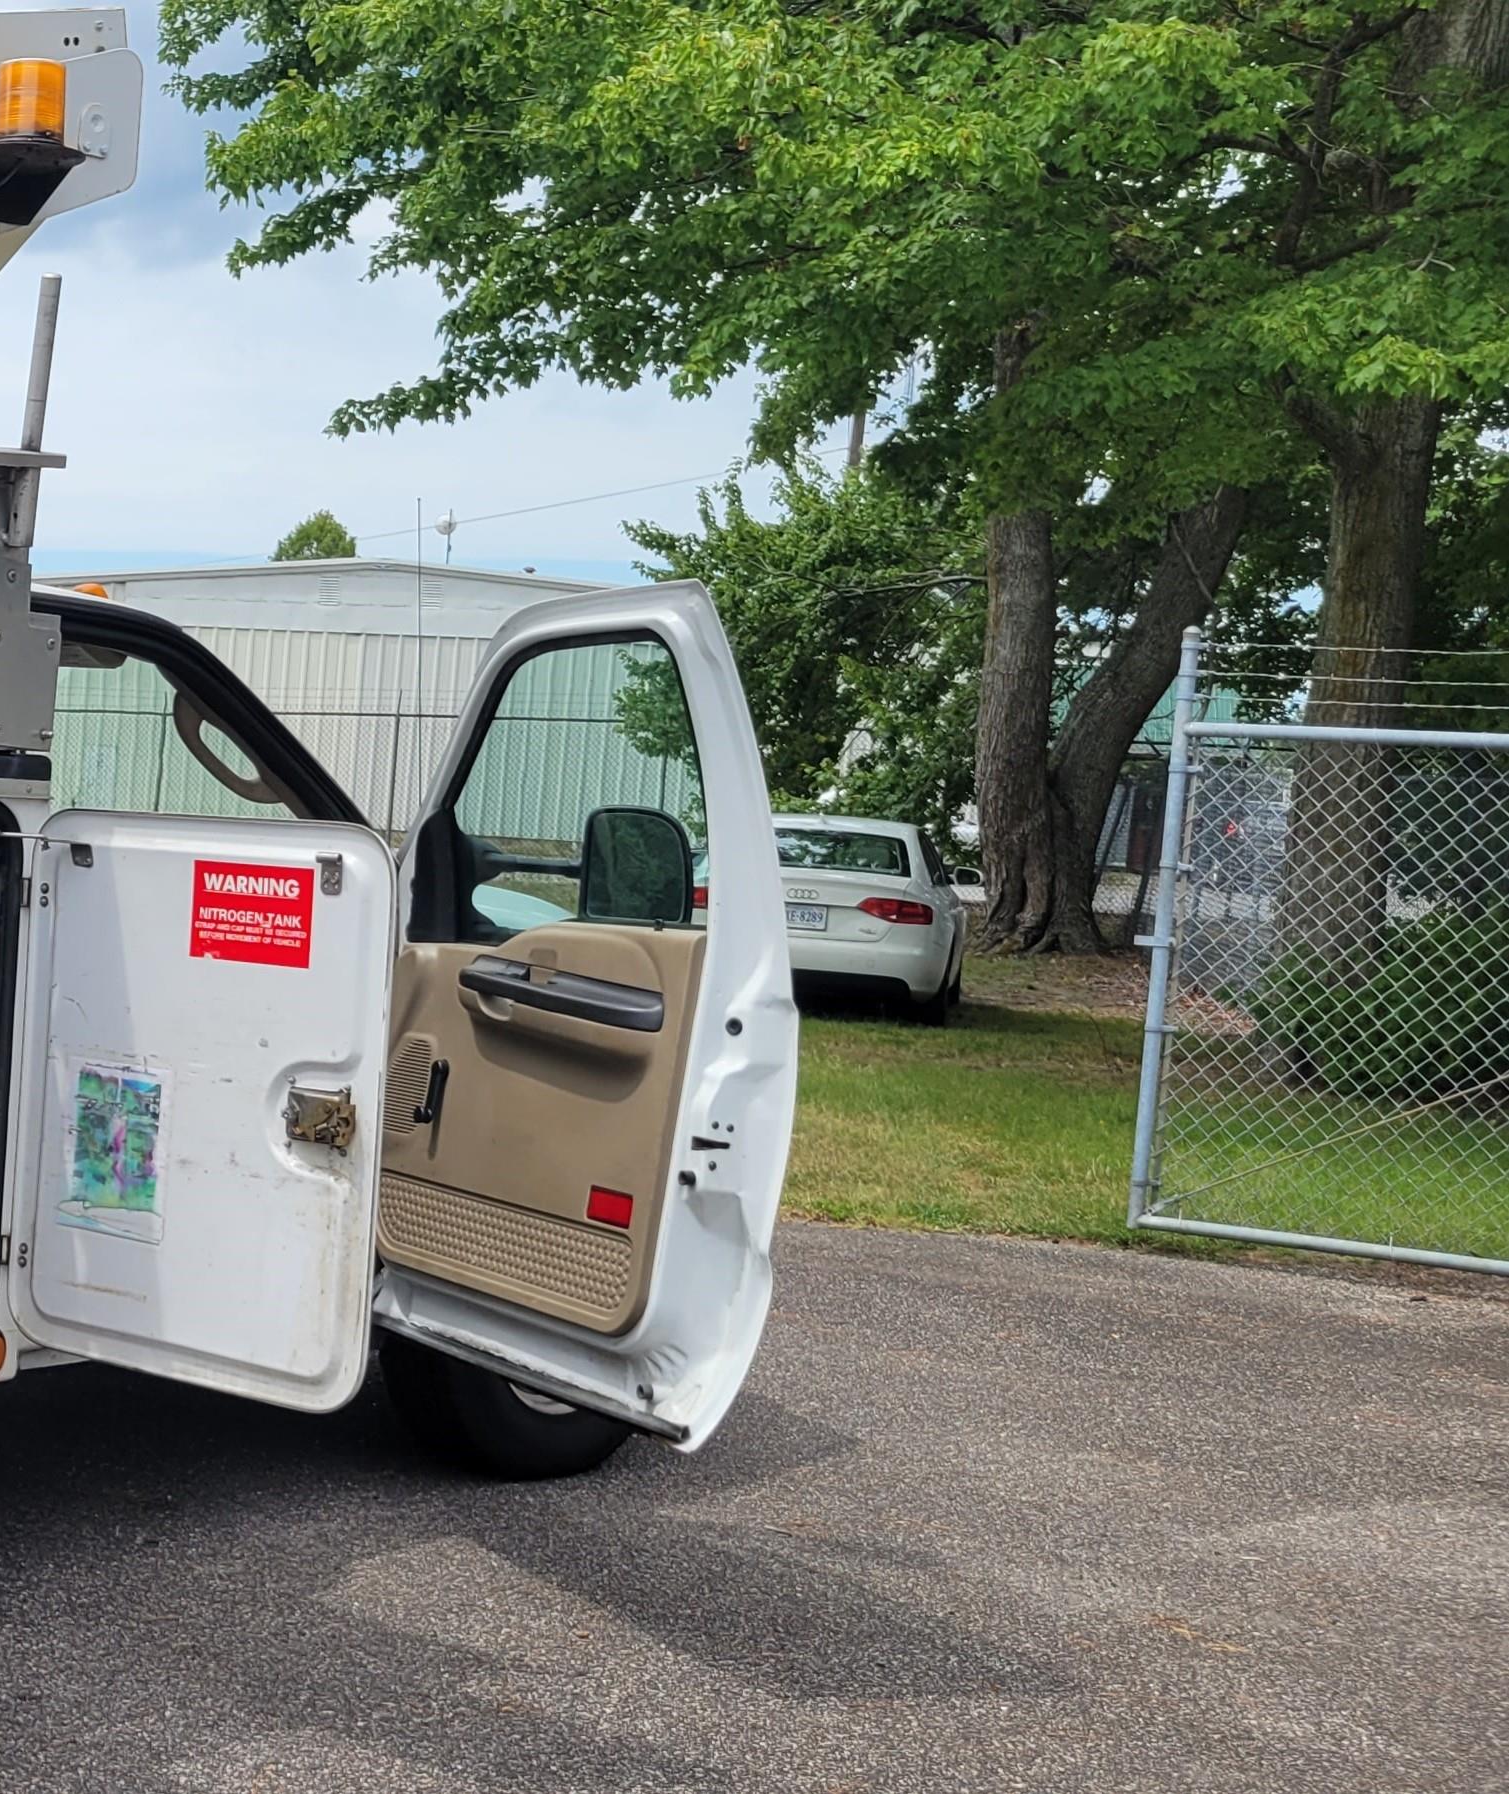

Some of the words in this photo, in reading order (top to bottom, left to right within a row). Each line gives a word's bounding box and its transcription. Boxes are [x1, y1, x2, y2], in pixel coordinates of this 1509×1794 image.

[203, 872, 300, 898] WARNING
[199, 906, 264, 925] NITROGEN
[265, 912, 302, 928] TANK
[216, 923, 231, 931] AND
[245, 926, 264, 934] MUST
[198, 930, 225, 941] BEFORE
[225, 933, 261, 944] MOVEMENT
[262, 936, 272, 944] OF
[273, 938, 301, 948] VEHICLE
